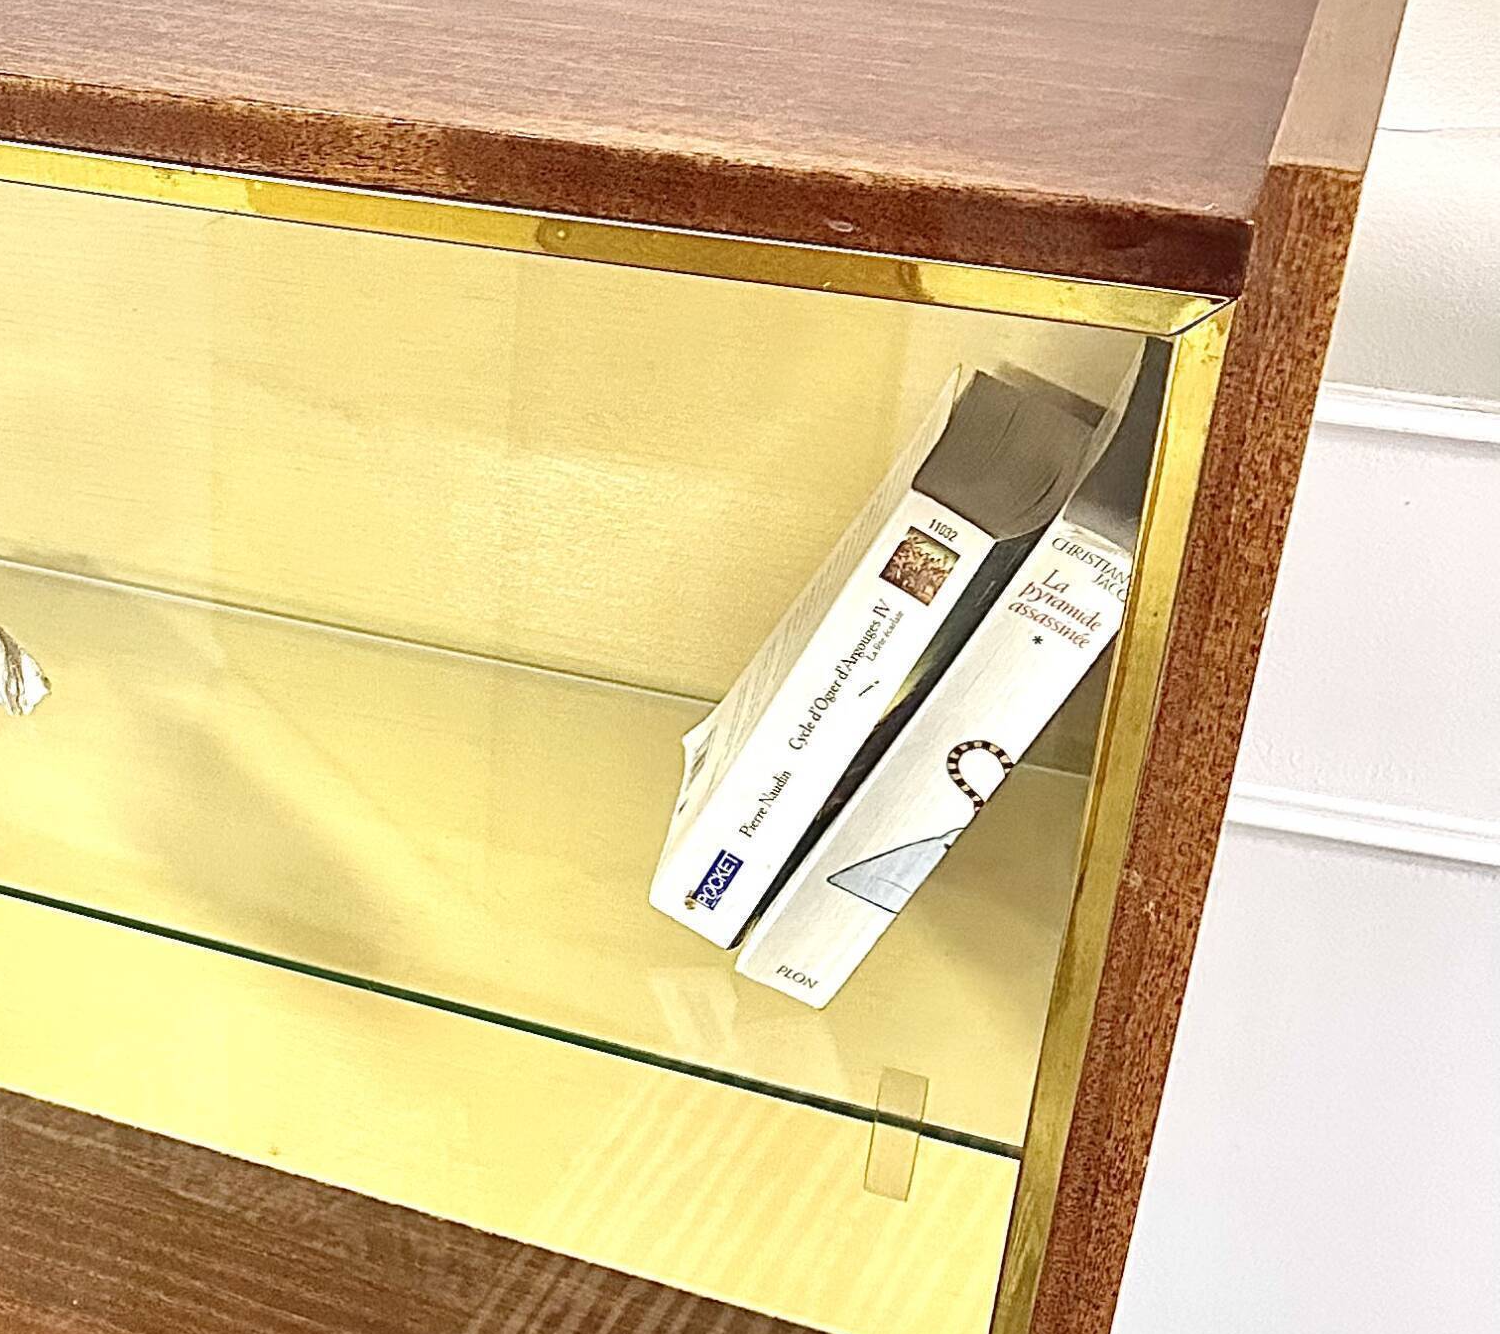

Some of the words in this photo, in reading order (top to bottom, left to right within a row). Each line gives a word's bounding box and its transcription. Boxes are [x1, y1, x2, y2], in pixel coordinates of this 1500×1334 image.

[928, 518, 959, 543] 11032
[1041, 568, 1070, 594] La
[1008, 602, 1090, 649] assassinée
[1018, 581, 1103, 633] pyramide
[788, 720, 816, 751] Cycle
[808, 679, 843, 723] d'Ogier
[835, 618, 882, 682] d'Argouges
[872, 598, 891, 620] IV
[738, 807, 768, 838] Pierre
[758, 769, 792, 808] Naudin
[697, 851, 741, 908] POCKET
[776, 964, 819, 989] PLON
